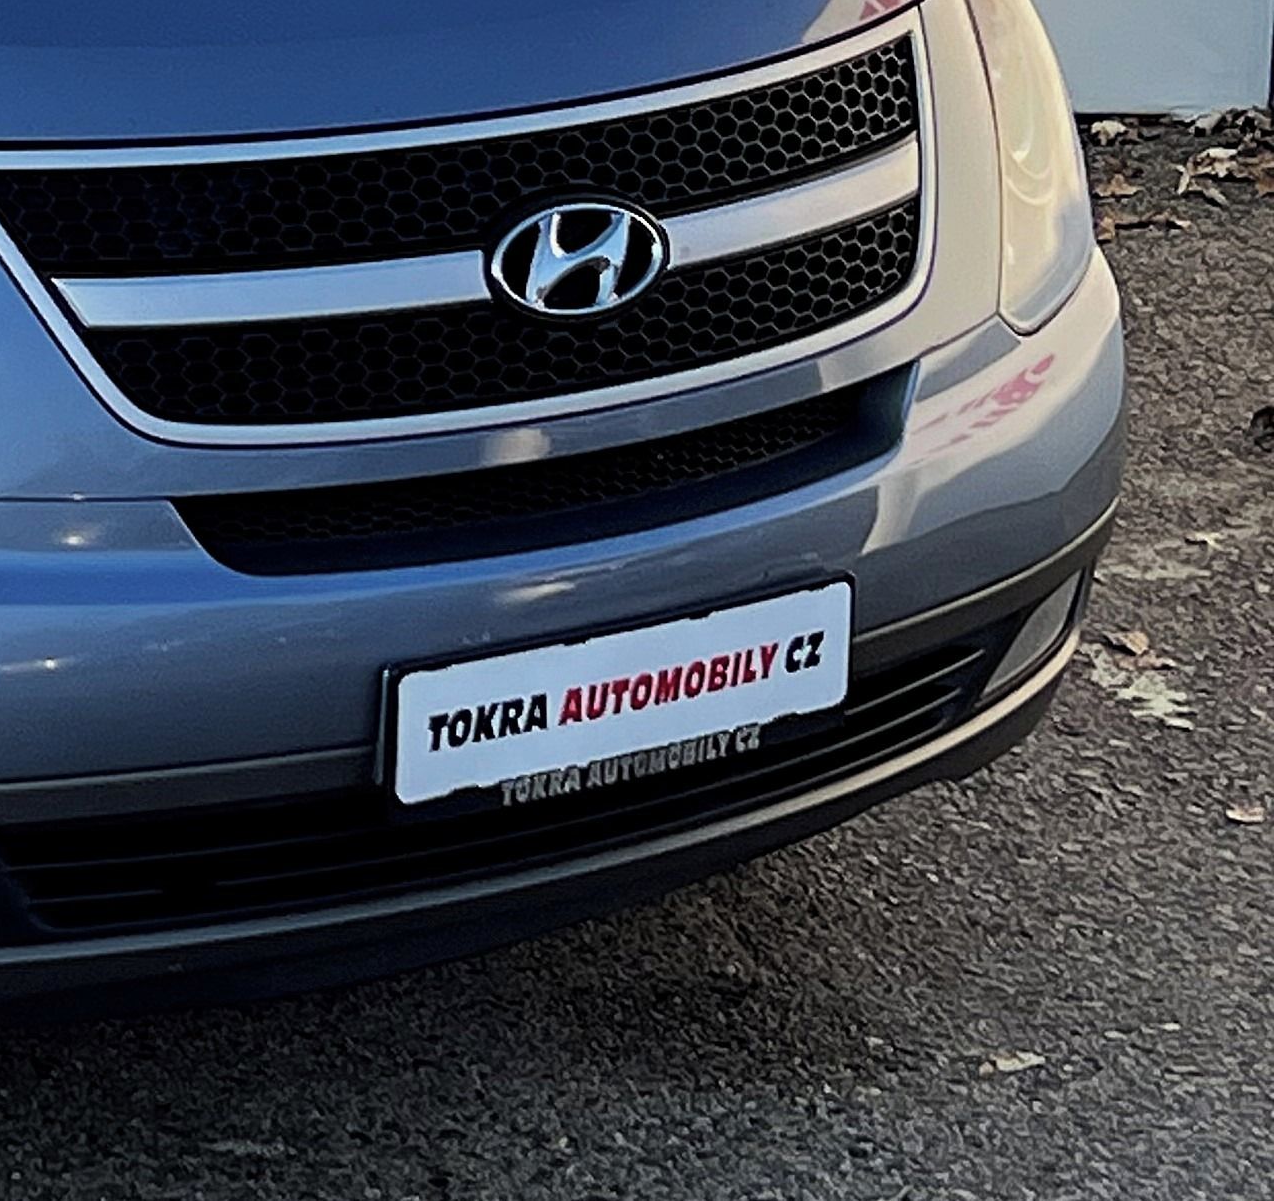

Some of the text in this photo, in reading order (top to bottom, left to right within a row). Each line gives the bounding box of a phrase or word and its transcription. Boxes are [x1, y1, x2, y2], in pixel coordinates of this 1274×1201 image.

[428, 631, 825, 752] TOKRA AUTOMOBILY CZ
[501, 724, 761, 807] TOKRA AUTOMOBILY CZ
